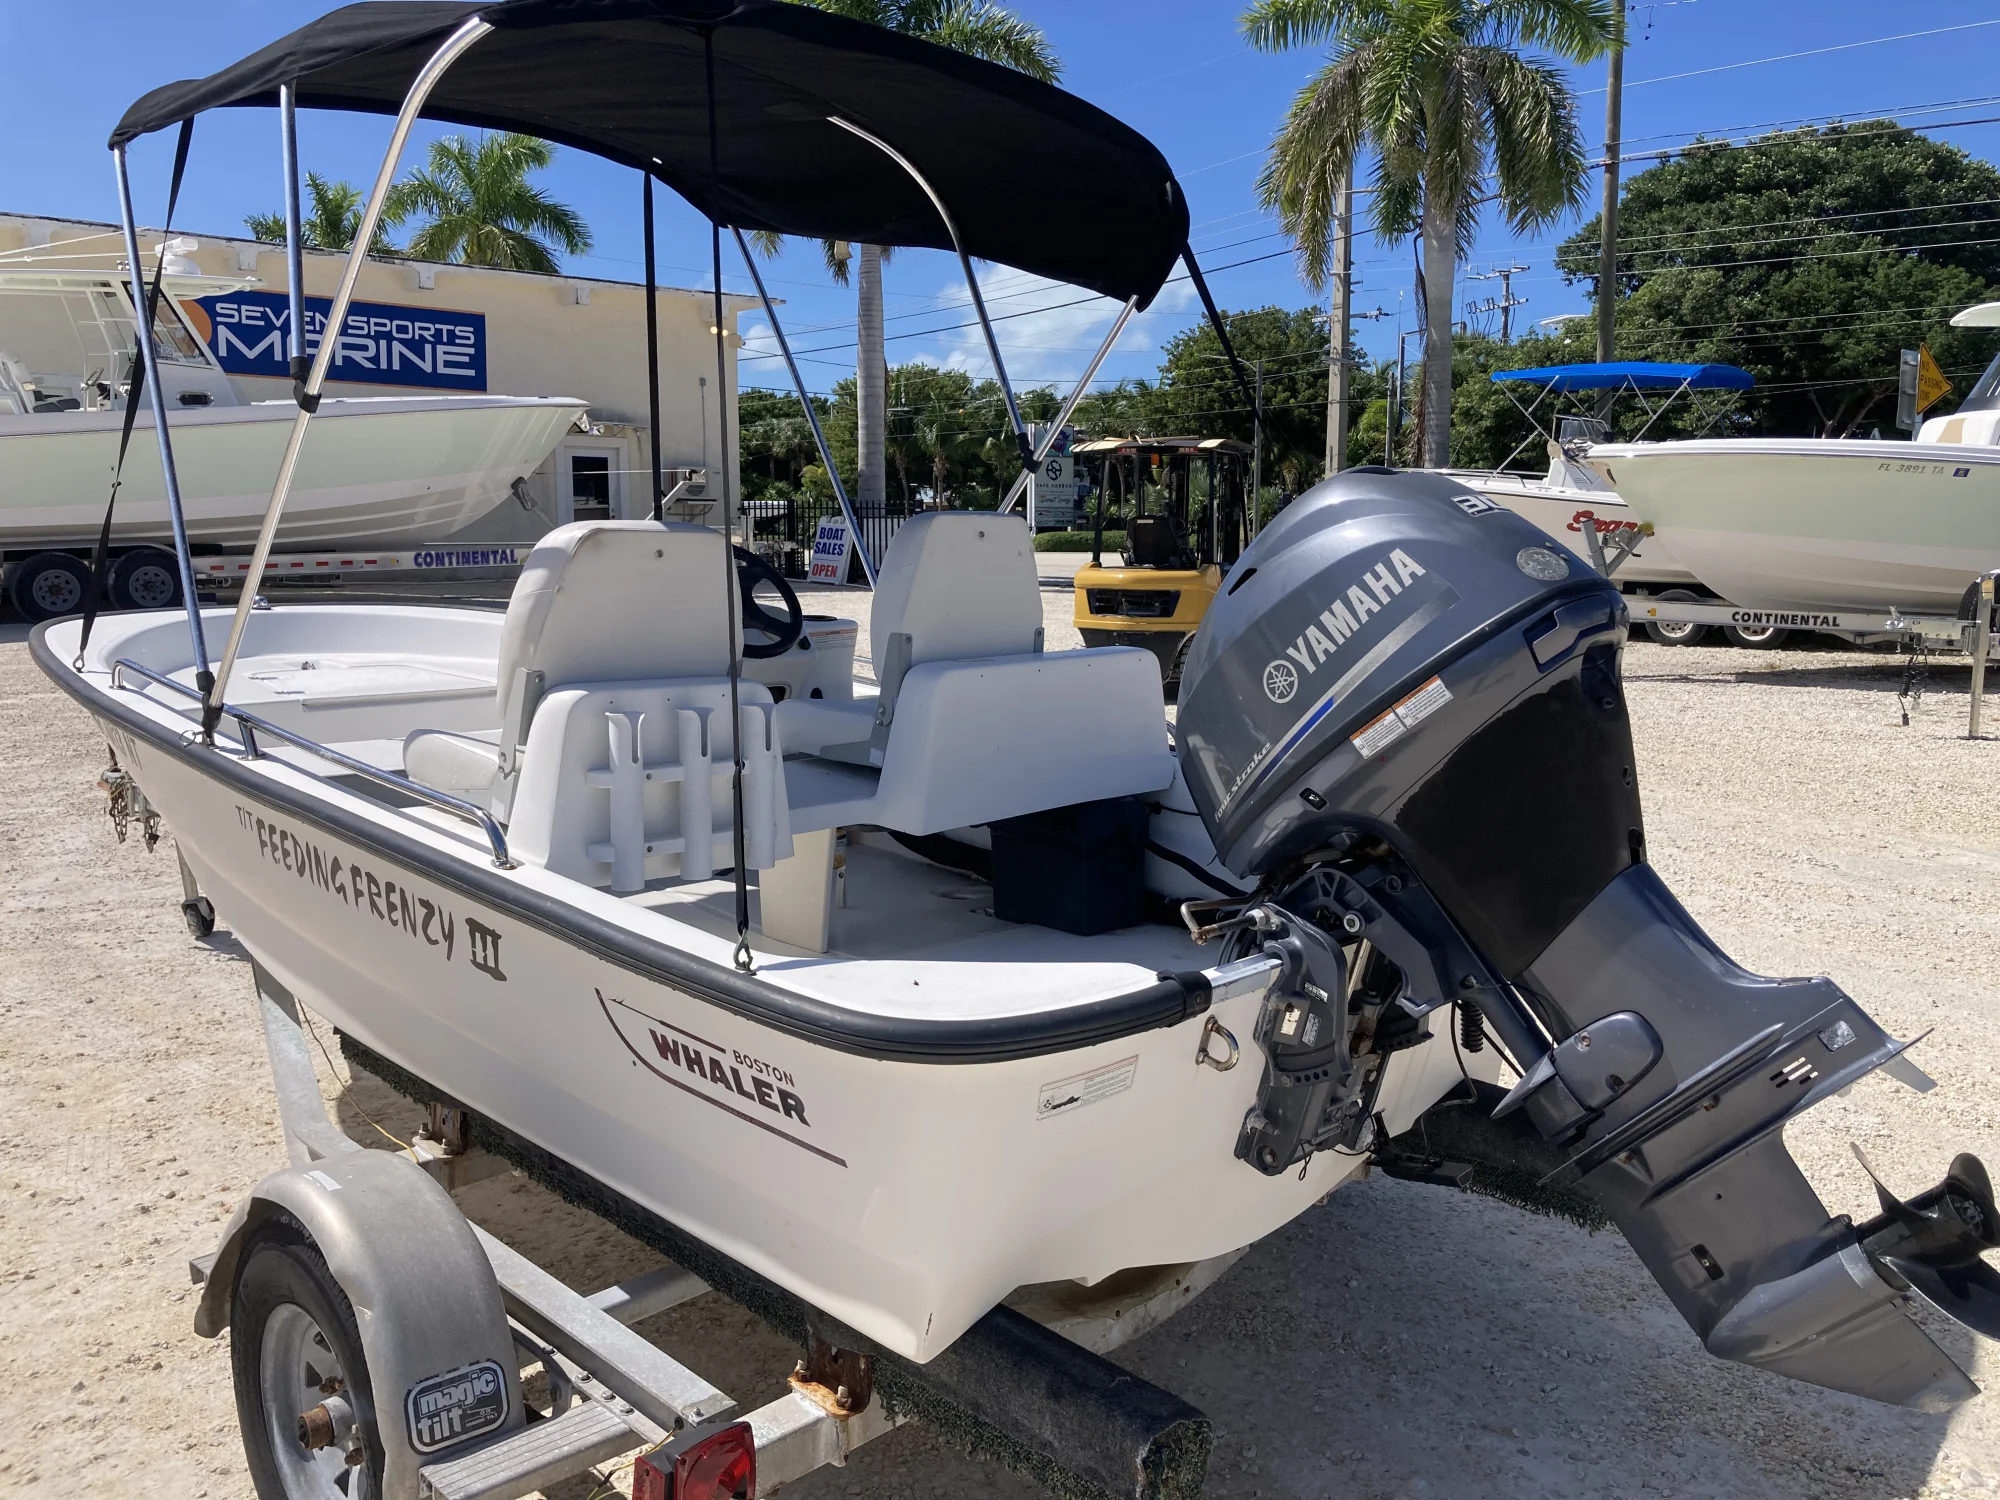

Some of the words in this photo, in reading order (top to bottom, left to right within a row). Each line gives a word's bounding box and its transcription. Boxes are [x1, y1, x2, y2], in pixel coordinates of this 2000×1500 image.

[347, 316, 475, 345] SPORTS
[1878, 463, 1891, 471] FL
[1896, 464, 1926, 474] 3891
[1931, 466, 1945, 475] TA
[818, 526, 846, 541] BOAT
[413, 548, 519, 568] CONTINENTAL
[814, 541, 845, 556] SALES
[811, 563, 838, 578] OPEN
[1286, 548, 1427, 675] YAMAHA
[1731, 611, 1840, 627] CONTINENTAL
[256, 816, 348, 906] FEEDING
[349, 863, 454, 962] FRENZY
[464, 917, 508, 981] III
[648, 1028, 812, 1128] WHALER
[732, 1049, 796, 1087] BOSTON
[418, 1371, 497, 1416] magic
[417, 1406, 463, 1443] tilt
